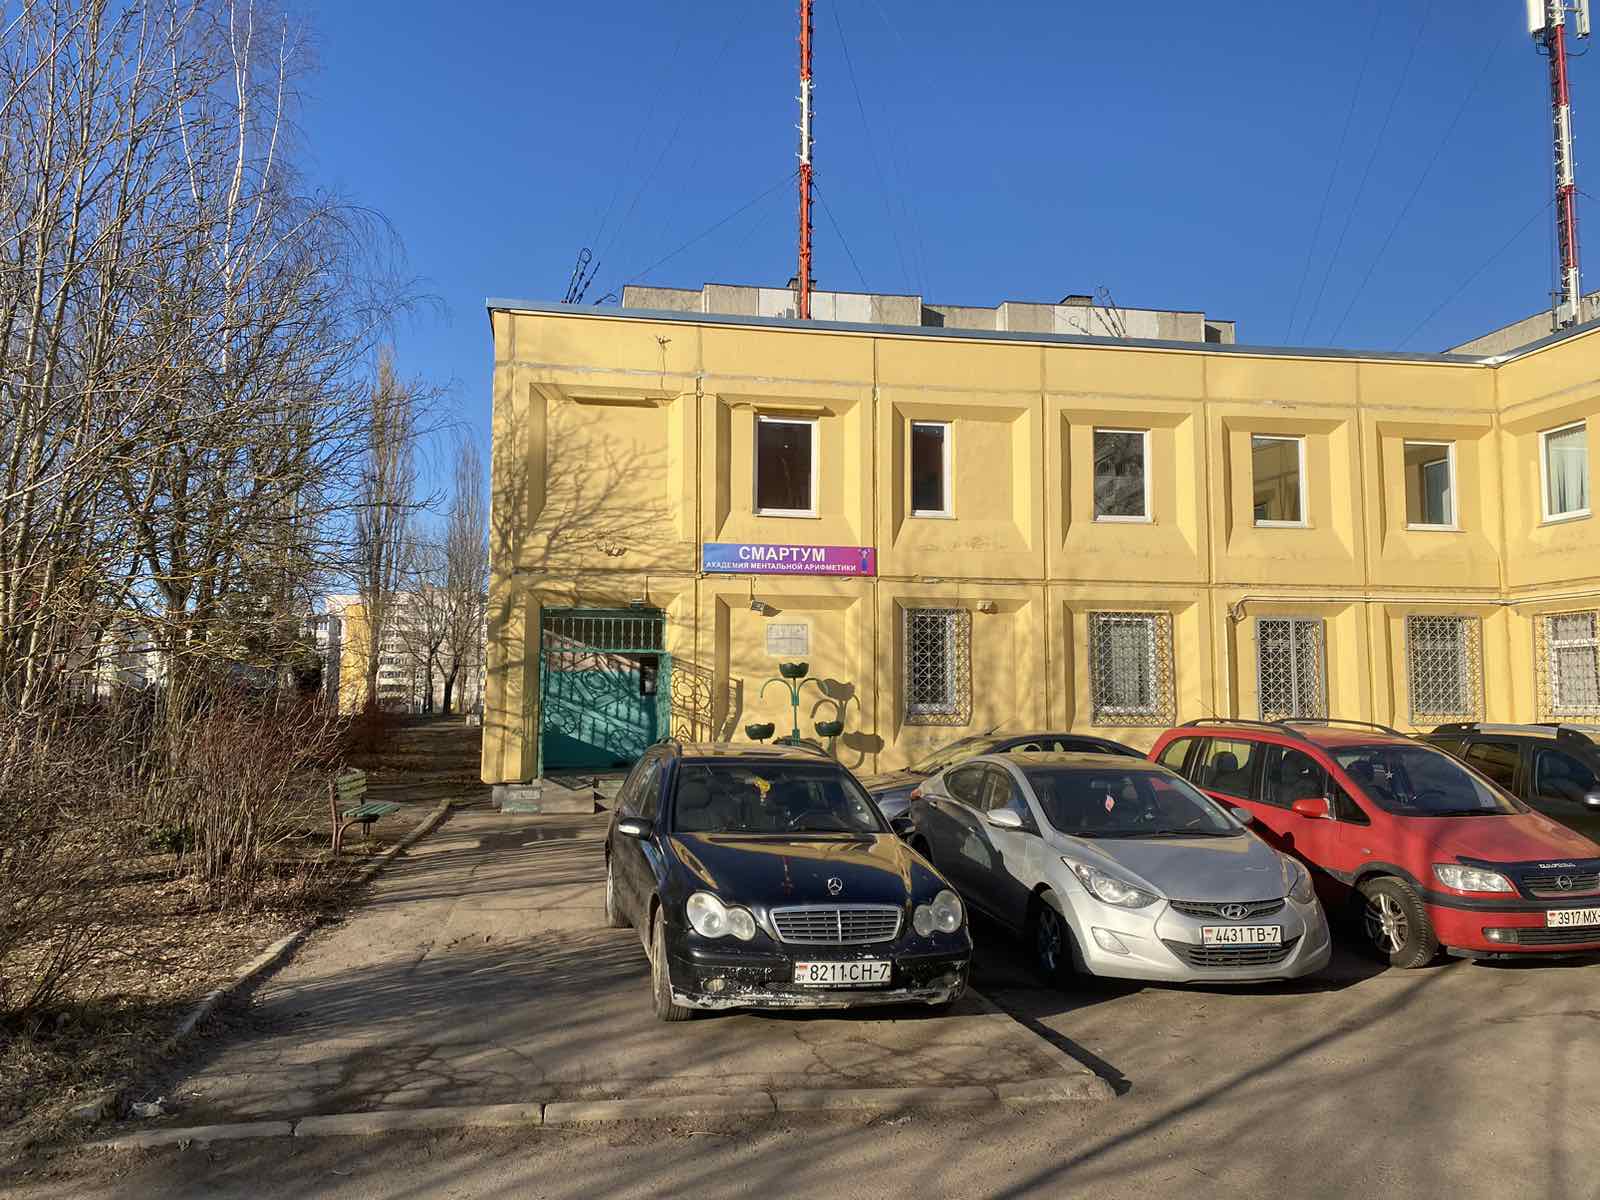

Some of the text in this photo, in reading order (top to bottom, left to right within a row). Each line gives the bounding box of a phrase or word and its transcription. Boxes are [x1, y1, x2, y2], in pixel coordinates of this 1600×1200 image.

[738, 547, 826, 562] СМАРТУМ
[751, 562, 803, 570] МЕНТАЛЬНОЙ
[804, 563, 857, 571] АРИФМЕТИКИ
[1558, 911, 1581, 924] 3917
[1216, 928, 1244, 942] 4431
[1247, 927, 1278, 942] TB-7
[810, 963, 890, 981] 8211 CH-7
